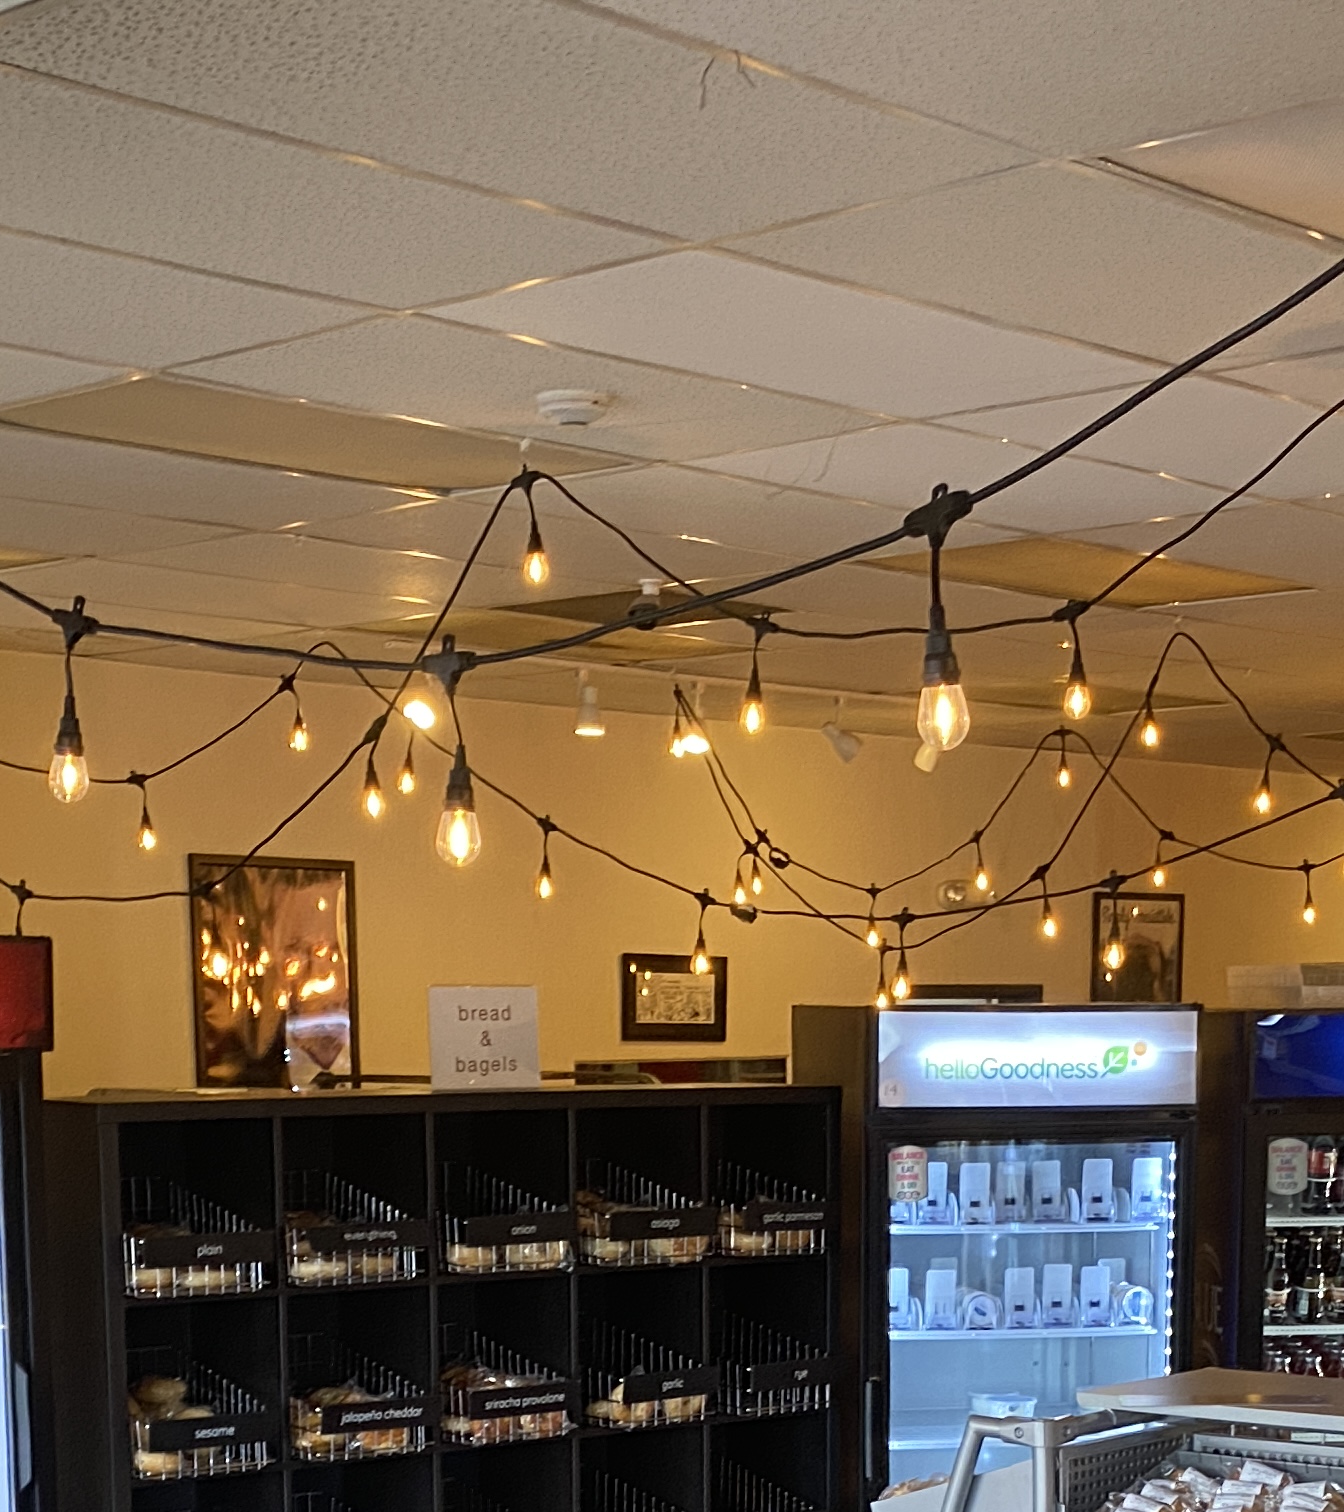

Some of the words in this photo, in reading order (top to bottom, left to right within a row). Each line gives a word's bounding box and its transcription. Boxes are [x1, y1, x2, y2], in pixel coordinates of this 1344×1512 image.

[458, 1005, 511, 1021] bread
[480, 1030, 492, 1047] &
[455, 1056, 518, 1077] bagels
[925, 1058, 1098, 1080] helloGoodness
[197, 1244, 223, 1258] plain
[662, 1378, 684, 1392] garlic
[384, 1406, 423, 1420] cheddar
[194, 1426, 235, 1439] sesame
